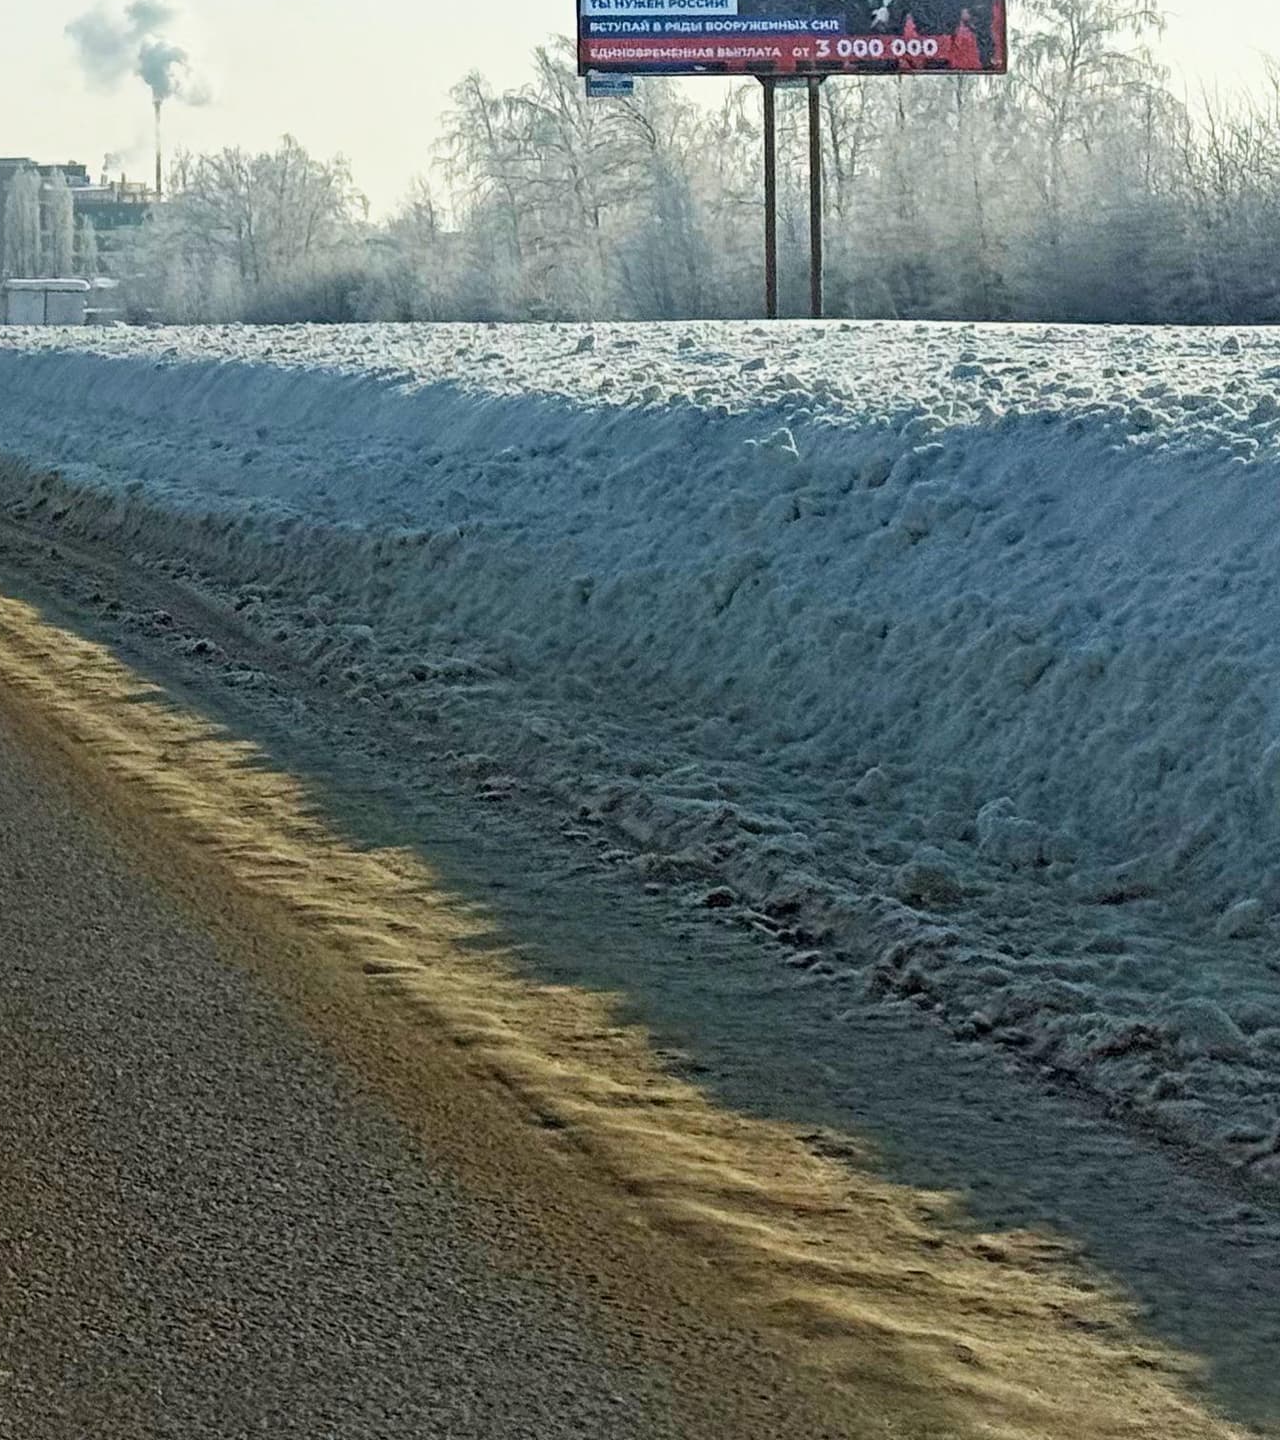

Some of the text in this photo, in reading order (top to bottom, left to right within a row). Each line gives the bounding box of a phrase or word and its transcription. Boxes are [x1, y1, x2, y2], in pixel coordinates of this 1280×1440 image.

[590, 19, 839, 33] ВСТУПАЙ В РЯДЫ ВООРУЖЕННЫХ СИЛ
[590, 38, 939, 60] ЕДИНОВРЕМЕННАЯ ВЫПЛАТА ОТ 3 000 000
